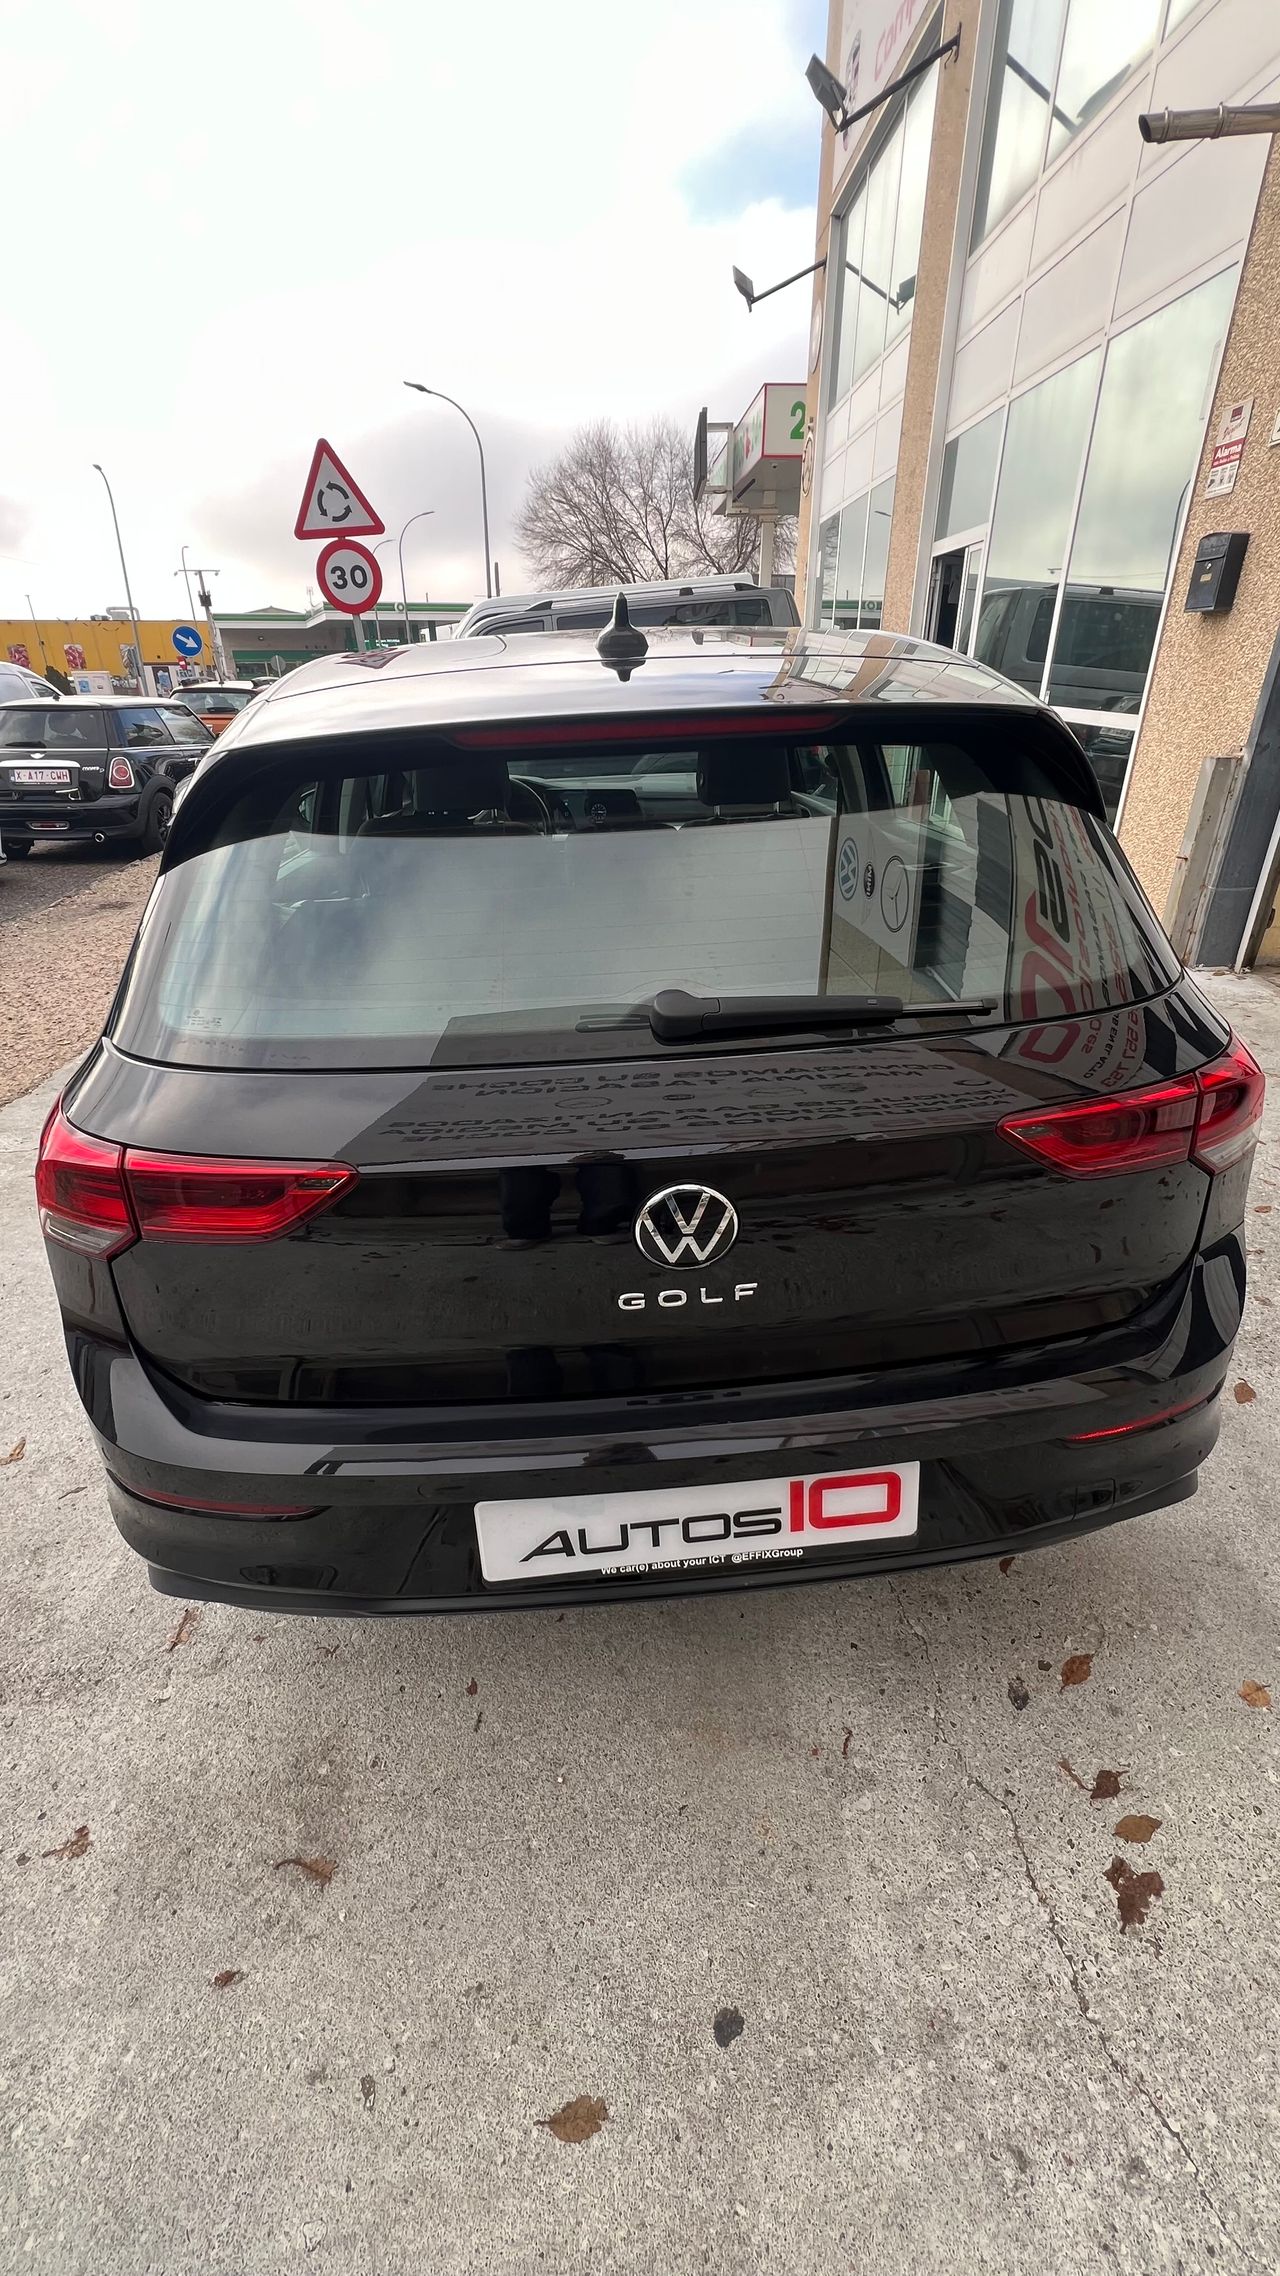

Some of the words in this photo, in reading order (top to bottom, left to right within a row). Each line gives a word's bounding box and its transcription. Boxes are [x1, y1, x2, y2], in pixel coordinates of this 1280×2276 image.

[1214, 443, 1243, 459] Alarma
[331, 565, 368, 589] 30
[618, 1282, 758, 1310] GOLF
[601, 1565, 617, 1575] We
[619, 1562, 649, 1573] car(e)
[651, 1559, 681, 1570] about
[683, 1557, 706, 1568] your
[709, 1554, 726, 1564] ICT
[731, 1548, 804, 1563] @EFFIXGroup
